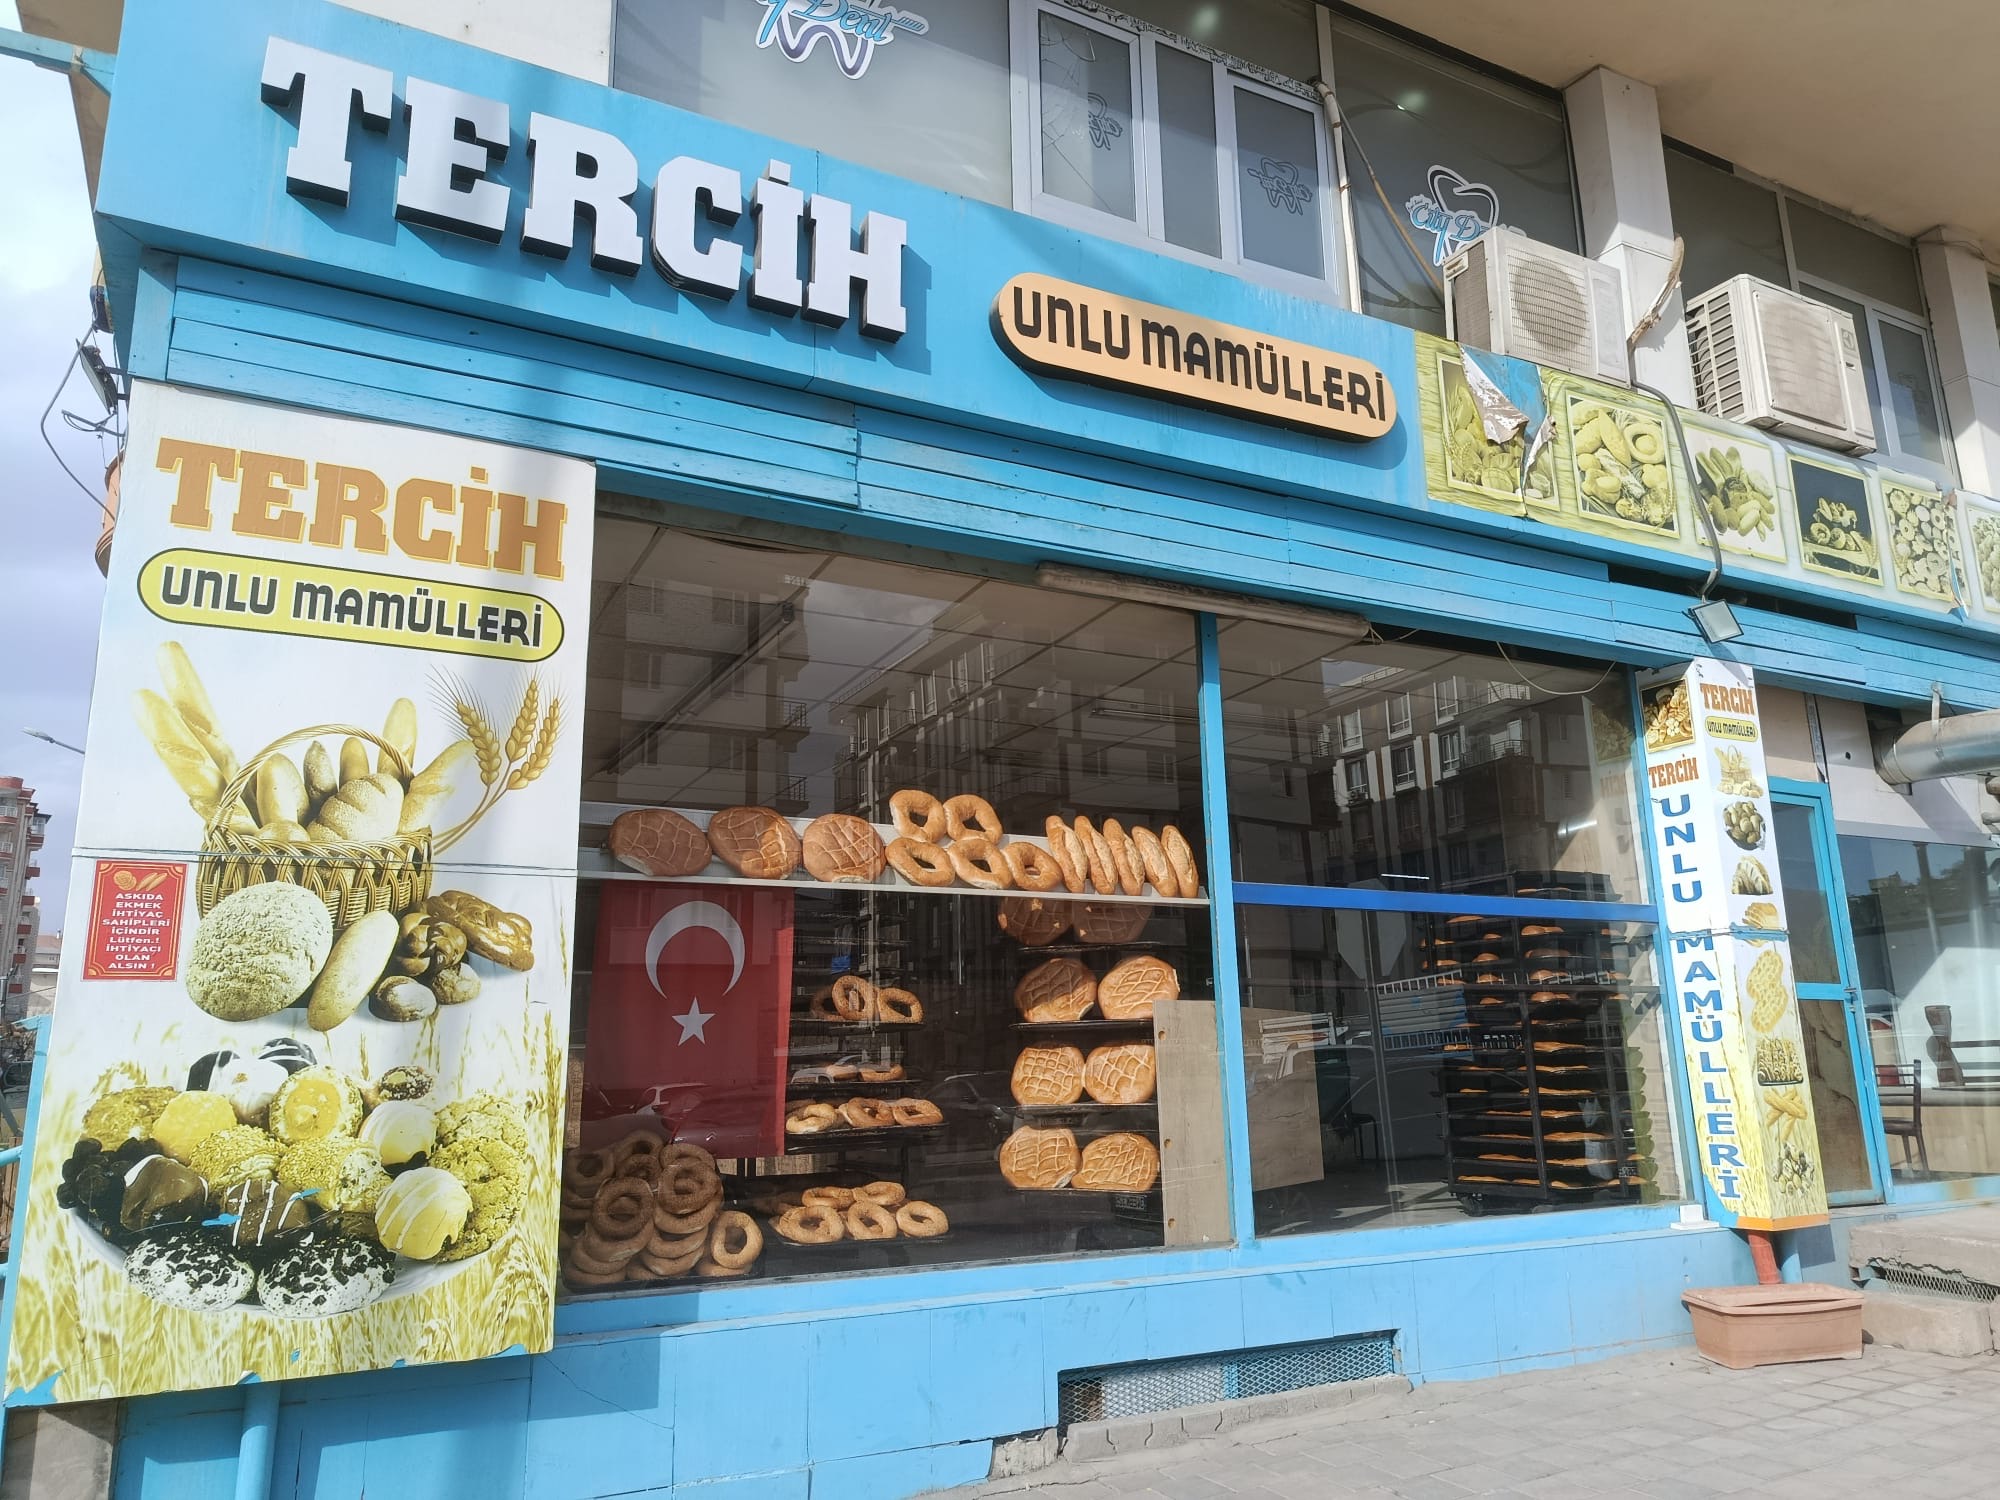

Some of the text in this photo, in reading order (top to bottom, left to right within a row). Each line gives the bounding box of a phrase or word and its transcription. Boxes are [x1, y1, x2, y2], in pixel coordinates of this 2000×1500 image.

[261, 36, 907, 341] TERCİH
[1013, 286, 1386, 421] UNLU MAMÜLLERİ
[155, 437, 567, 581] TERCİH
[161, 565, 542, 648] UNLU MAMÜLLERİ
[1700, 681, 1755, 715] TERCİH
[1648, 753, 1699, 789] TERCİH
[1661, 794, 1703, 903] UNLU
[102, 918, 170, 927] SAHİPLERİ
[111, 927, 160, 936] İÇİNDİR
[112, 909, 164, 918] İHTİYAÇ
[105, 944, 161, 952] İHTİYACI
